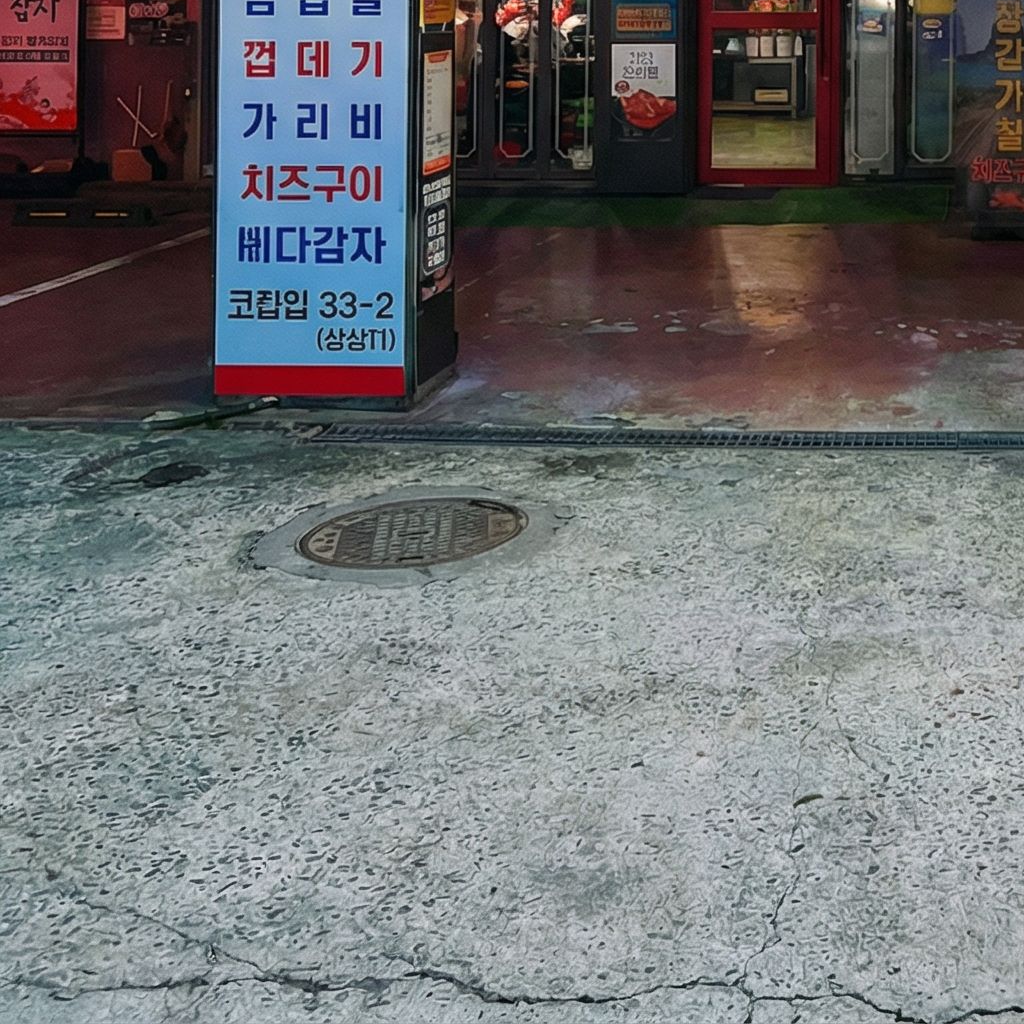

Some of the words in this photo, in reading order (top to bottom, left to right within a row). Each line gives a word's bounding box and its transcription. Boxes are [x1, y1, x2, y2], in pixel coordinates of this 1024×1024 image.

[243, 103, 382, 140] 가리비
[241, 164, 383, 203] 치즈구이
[319, 291, 394, 319] 33-2
